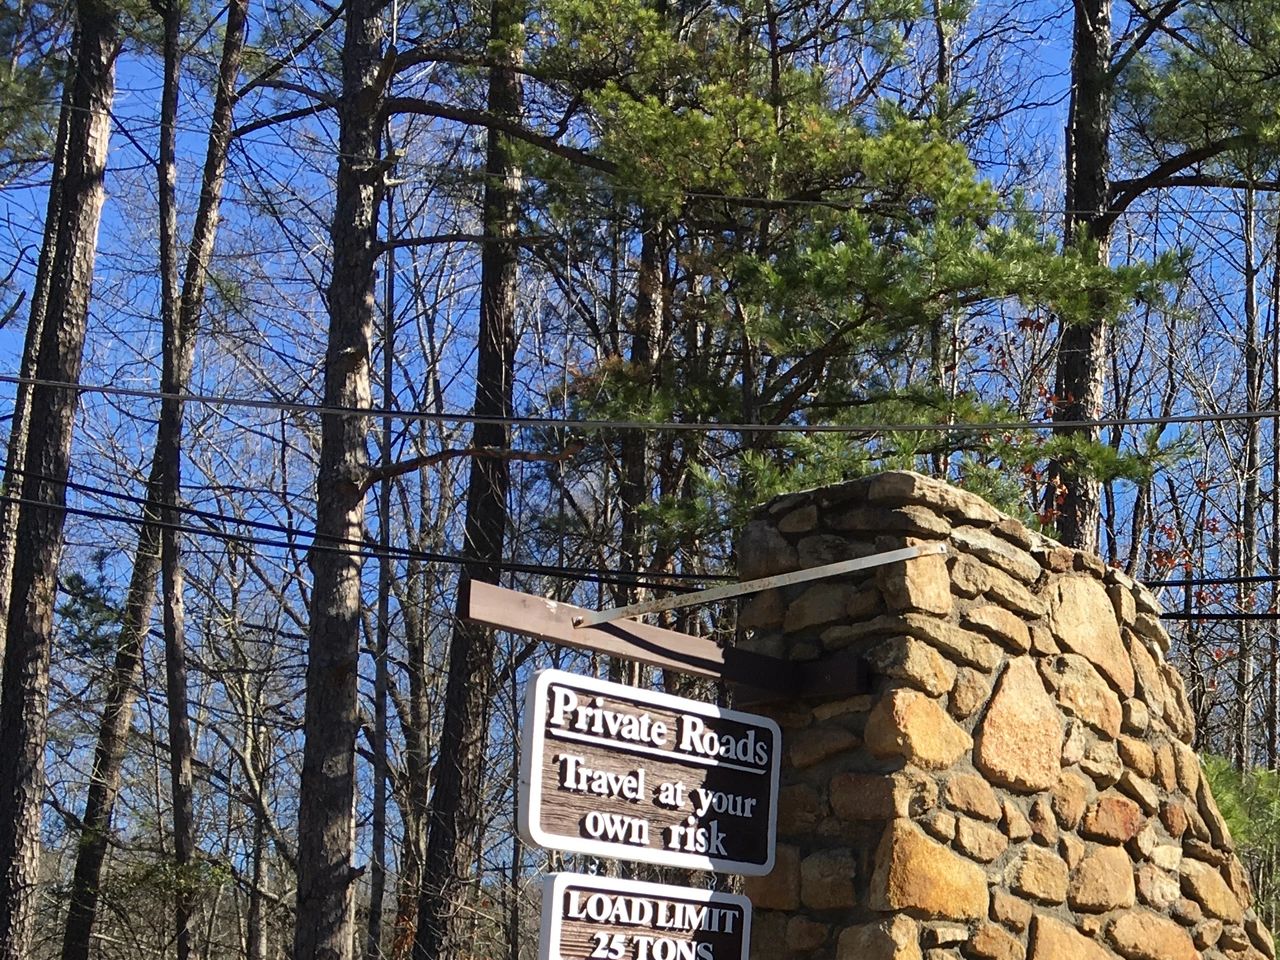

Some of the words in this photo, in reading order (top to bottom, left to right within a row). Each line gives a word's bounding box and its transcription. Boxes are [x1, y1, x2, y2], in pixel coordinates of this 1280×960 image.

[550, 685, 667, 746] Private
[679, 714, 768, 766] Roads
[559, 753, 645, 801] Travel
[659, 780, 686, 805] at
[697, 789, 756, 818] your
[585, 811, 649, 844] own
[670, 815, 727, 857] risk
[567, 890, 653, 924] LOAD
[656, 898, 738, 934] LIMIT
[591, 934, 626, 959] 25
